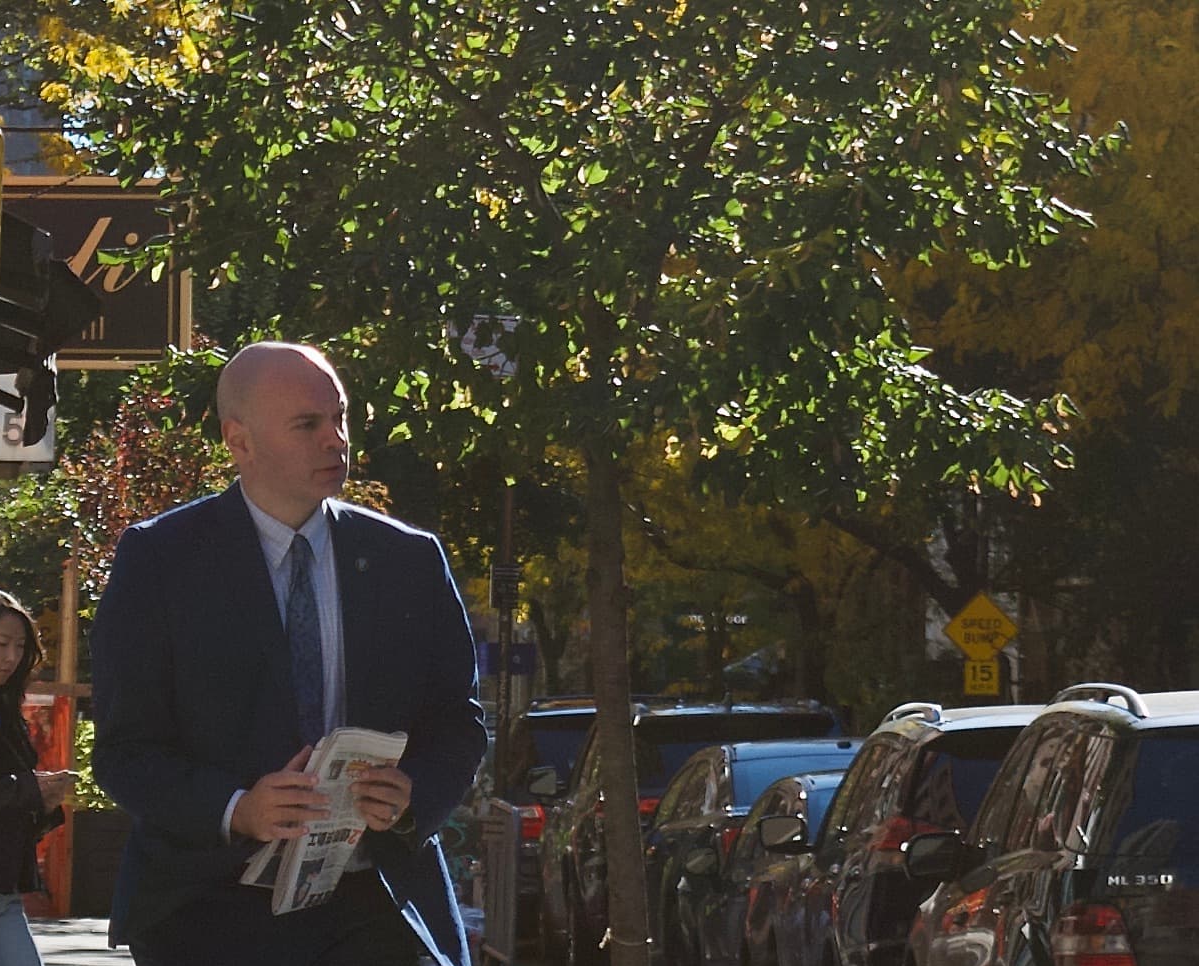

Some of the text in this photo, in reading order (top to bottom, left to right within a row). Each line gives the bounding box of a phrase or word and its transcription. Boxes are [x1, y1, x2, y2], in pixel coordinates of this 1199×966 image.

[961, 617, 1002, 630] SPEED
[963, 630, 999, 645] BUMP
[971, 665, 994, 682] 15
[1107, 874, 1173, 886] ML 350
